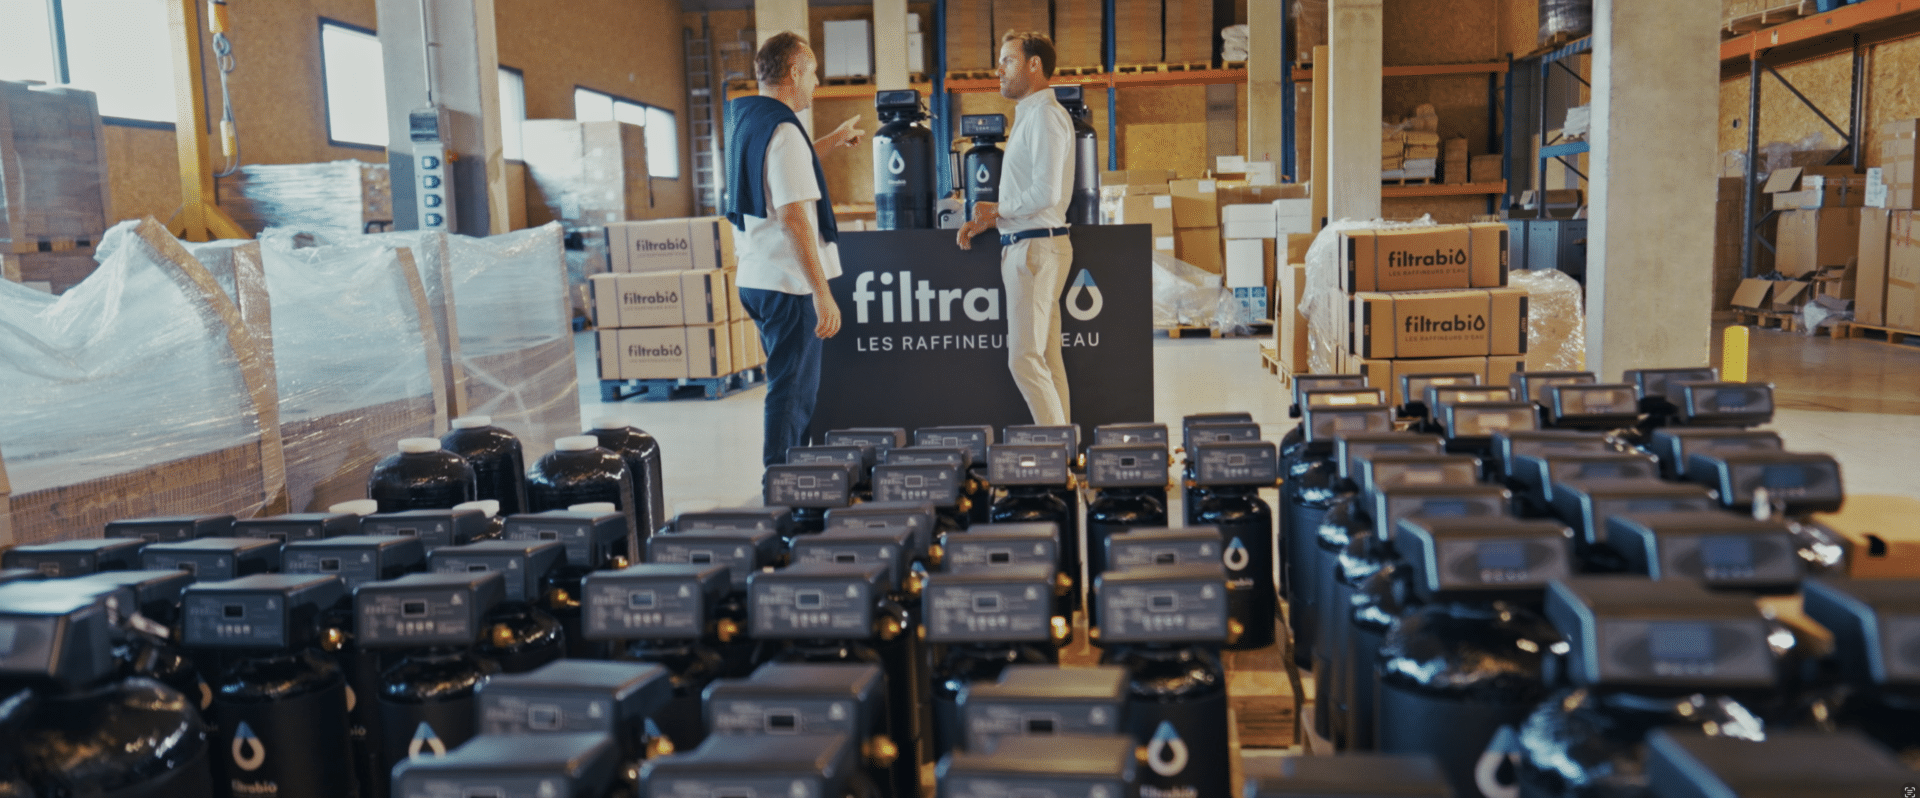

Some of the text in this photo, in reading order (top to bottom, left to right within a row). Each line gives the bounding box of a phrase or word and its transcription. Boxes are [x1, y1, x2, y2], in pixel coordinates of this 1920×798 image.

[1388, 248, 1467, 268] filtrabio
[853, 268, 1104, 324] filtrao
[1405, 313, 1486, 333] filtrabio
[857, 332, 1100, 351] LES RAFFINEU EAU
